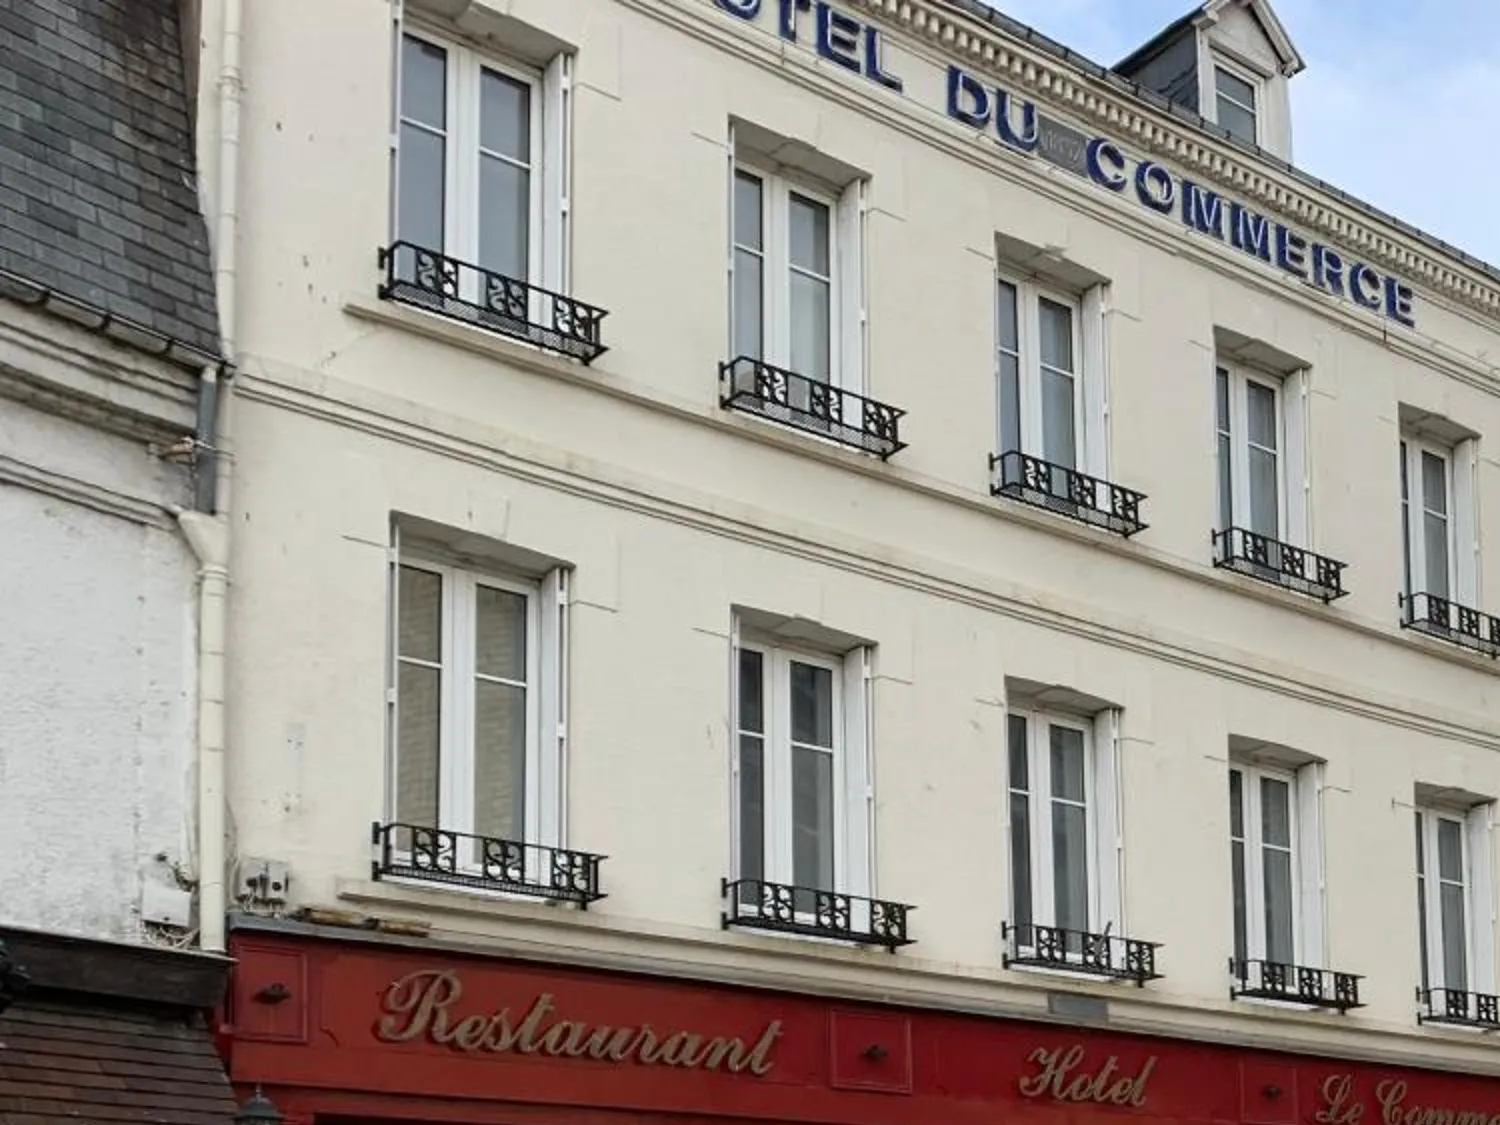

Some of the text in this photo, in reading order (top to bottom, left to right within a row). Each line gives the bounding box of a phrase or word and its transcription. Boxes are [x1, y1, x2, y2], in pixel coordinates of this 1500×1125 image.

[713, 0, 902, 93] TEL
[947, 63, 1039, 152] DU
[1086, 136, 1416, 328] COMMERCE
[377, 967, 784, 1076] Restaurant
[1019, 1044, 1158, 1107] Hotel
